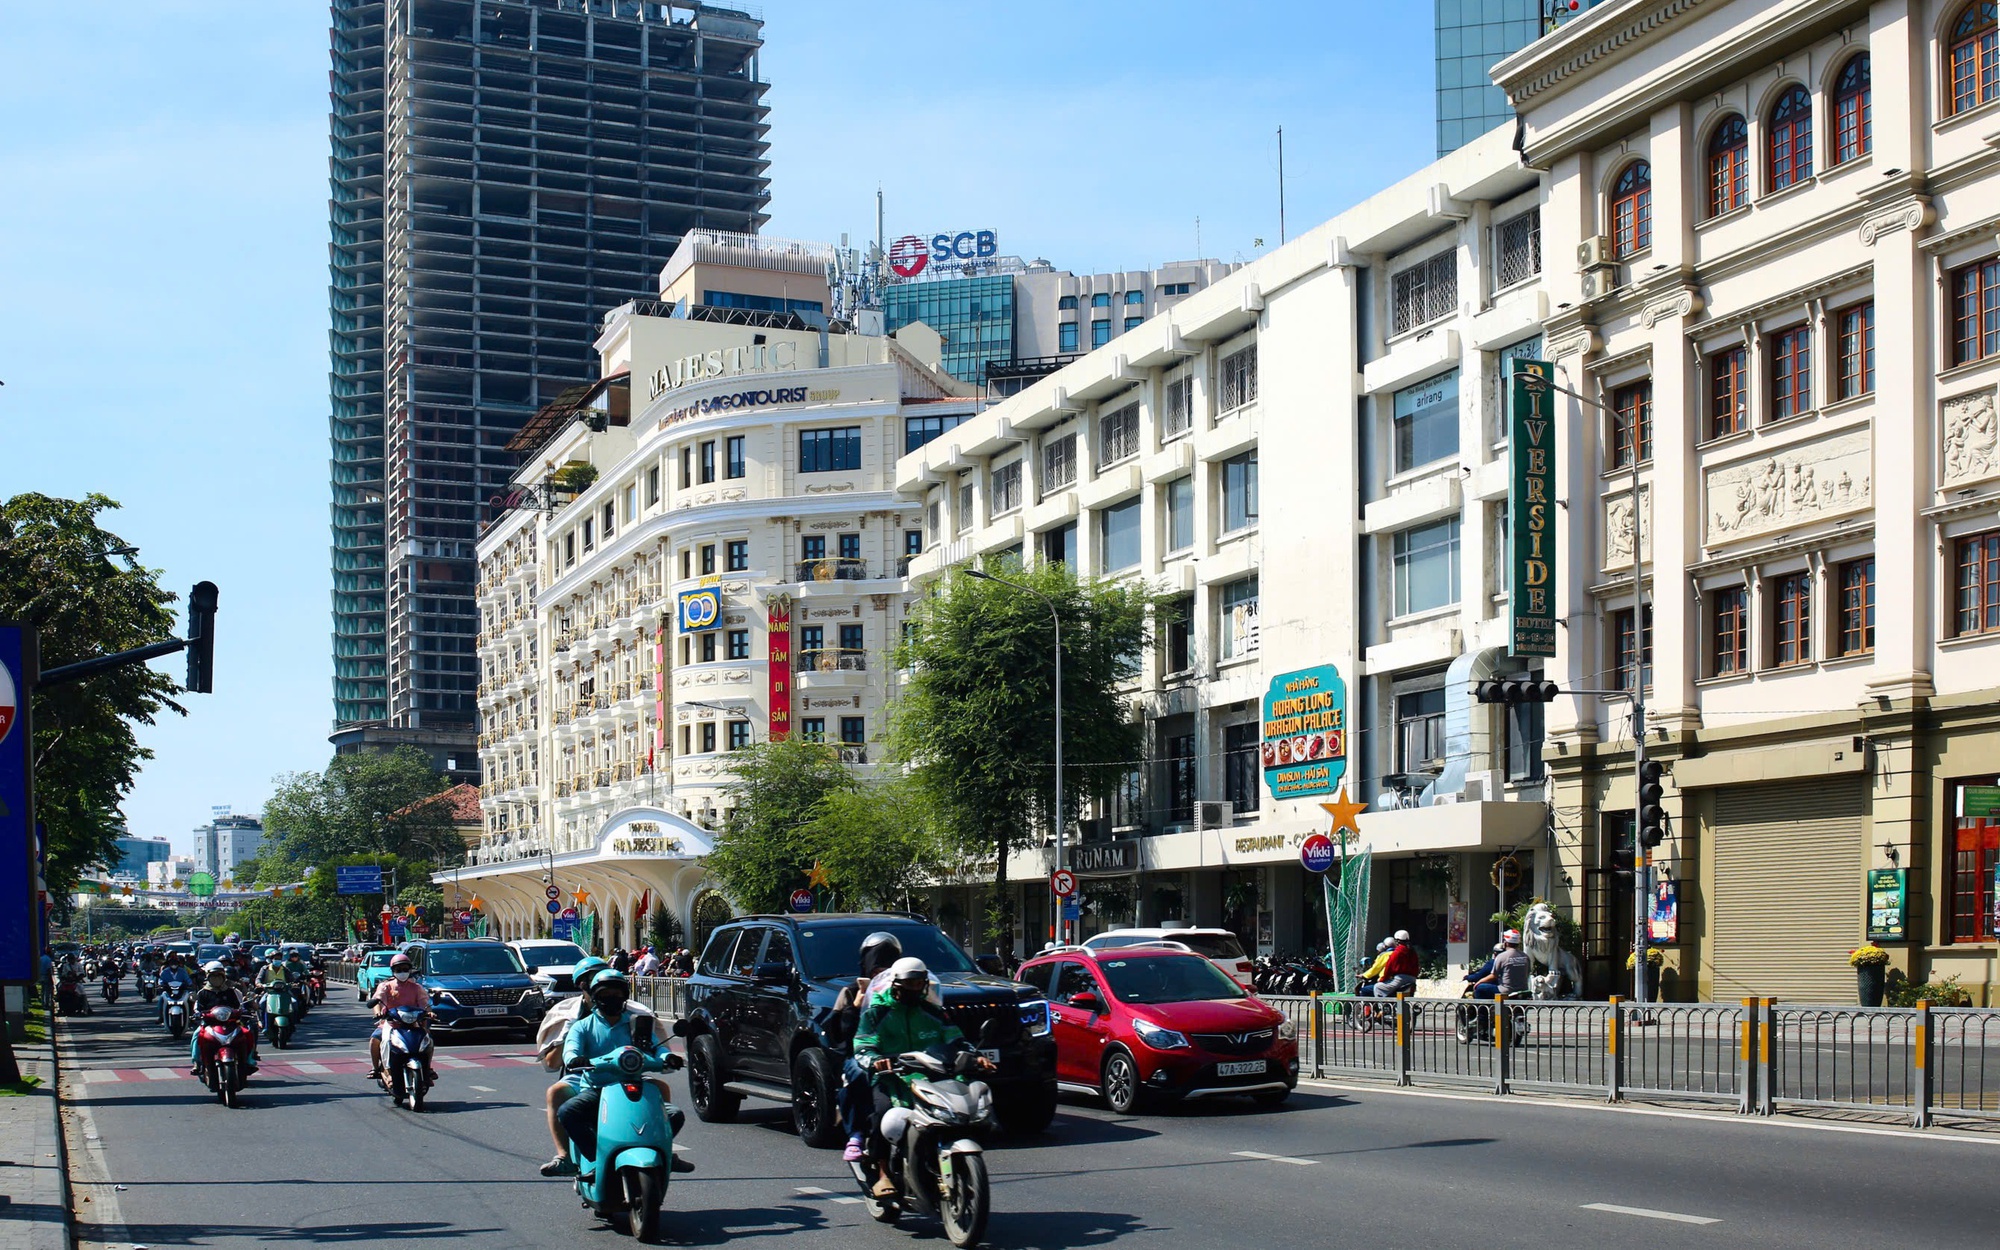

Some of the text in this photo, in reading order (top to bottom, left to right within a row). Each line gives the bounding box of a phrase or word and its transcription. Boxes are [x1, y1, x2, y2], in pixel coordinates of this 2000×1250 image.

[932, 230, 996, 261] SCB
[649, 341, 797, 400] MAJESTIC
[1417, 391, 1442, 407] arirang
[658, 386, 840, 431] Member of SAIGONTOURIST GROUP
[1523, 364, 1548, 614] RIVERSIDE
[680, 592, 718, 629] 100
[768, 620, 789, 633] NÂNG
[1516, 617, 1555, 629] HOTEL
[771, 647, 787, 662] TẦM
[775, 682, 783, 692] DI
[1305, 691, 1332, 711] LONG
[772, 707, 787, 722] SẢN
[1265, 709, 1342, 737] DRAGON PALACE
[628, 822, 660, 833] HOTEL
[1235, 834, 1285, 853] RESTAURANT
[1304, 841, 1331, 858] Vikki
[793, 893, 811, 904] Vikki
